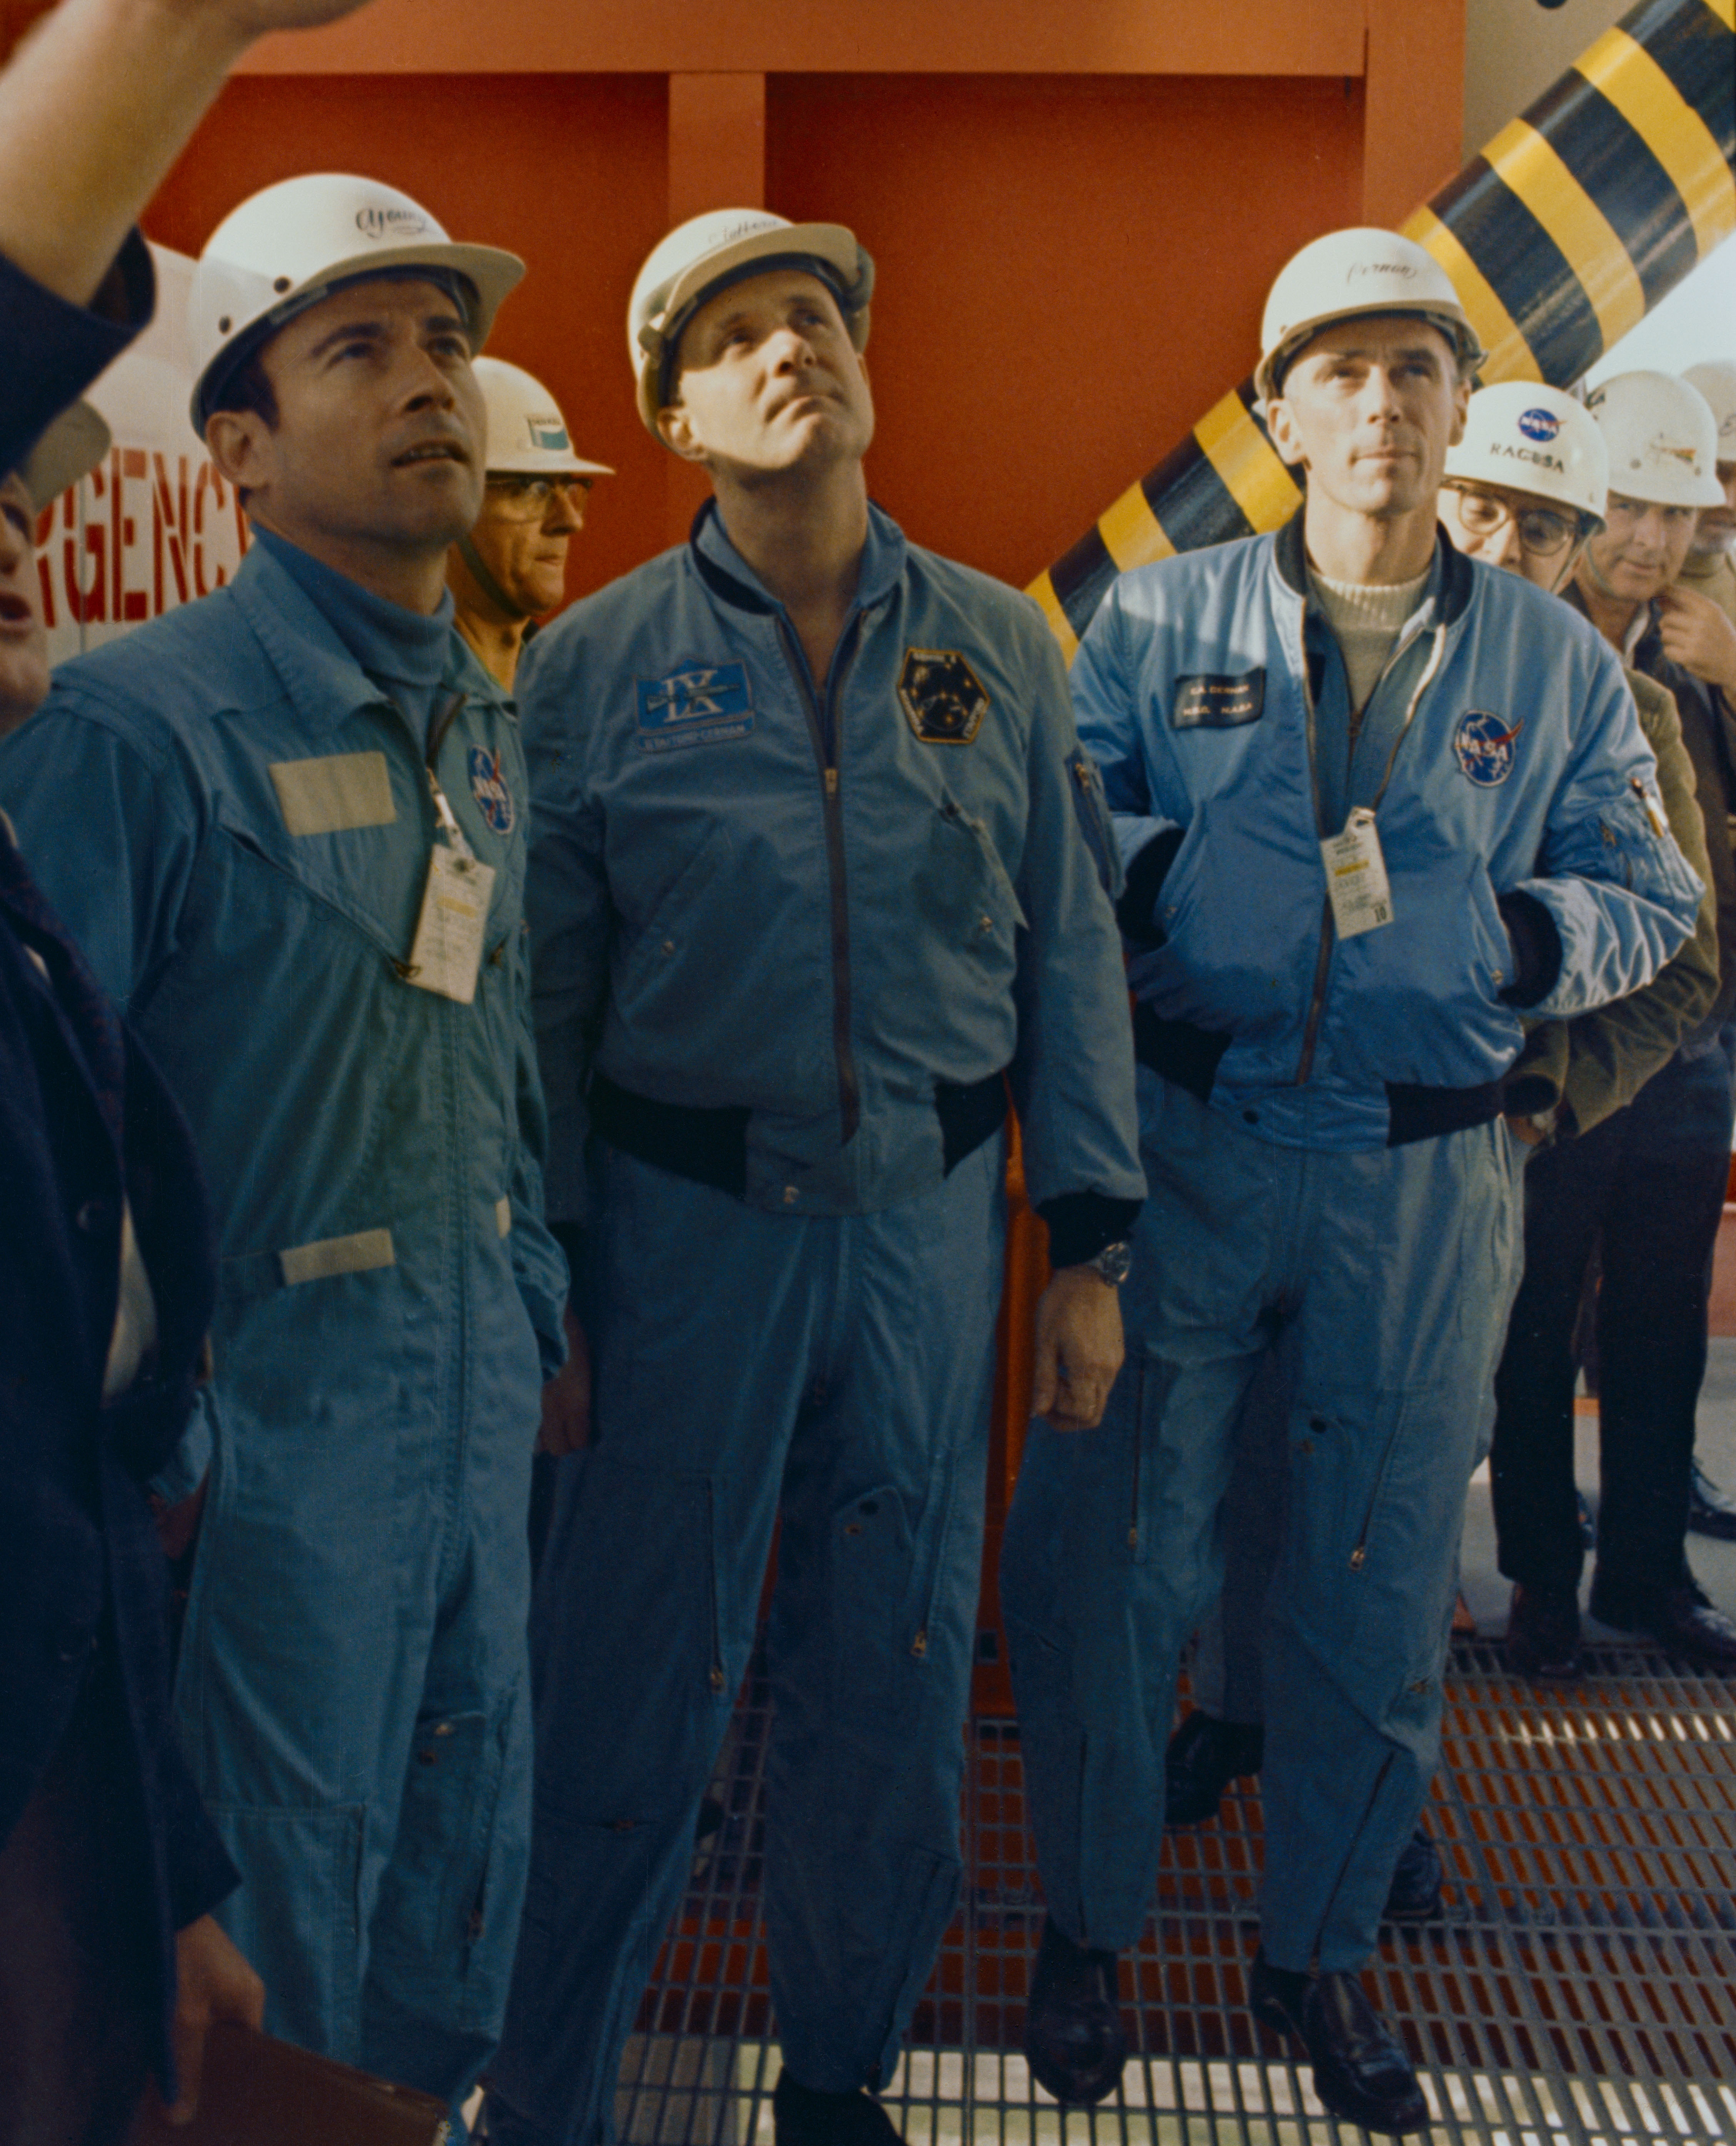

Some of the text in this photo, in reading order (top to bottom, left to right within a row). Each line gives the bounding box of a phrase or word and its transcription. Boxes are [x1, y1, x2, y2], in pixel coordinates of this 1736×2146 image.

[1520, 416, 1559, 434] NASA
[1489, 443, 1564, 474] RAGUSA
[35, 446, 249, 628] GENC
[661, 670, 724, 723] IX
[1456, 731, 1509, 762] NASA
